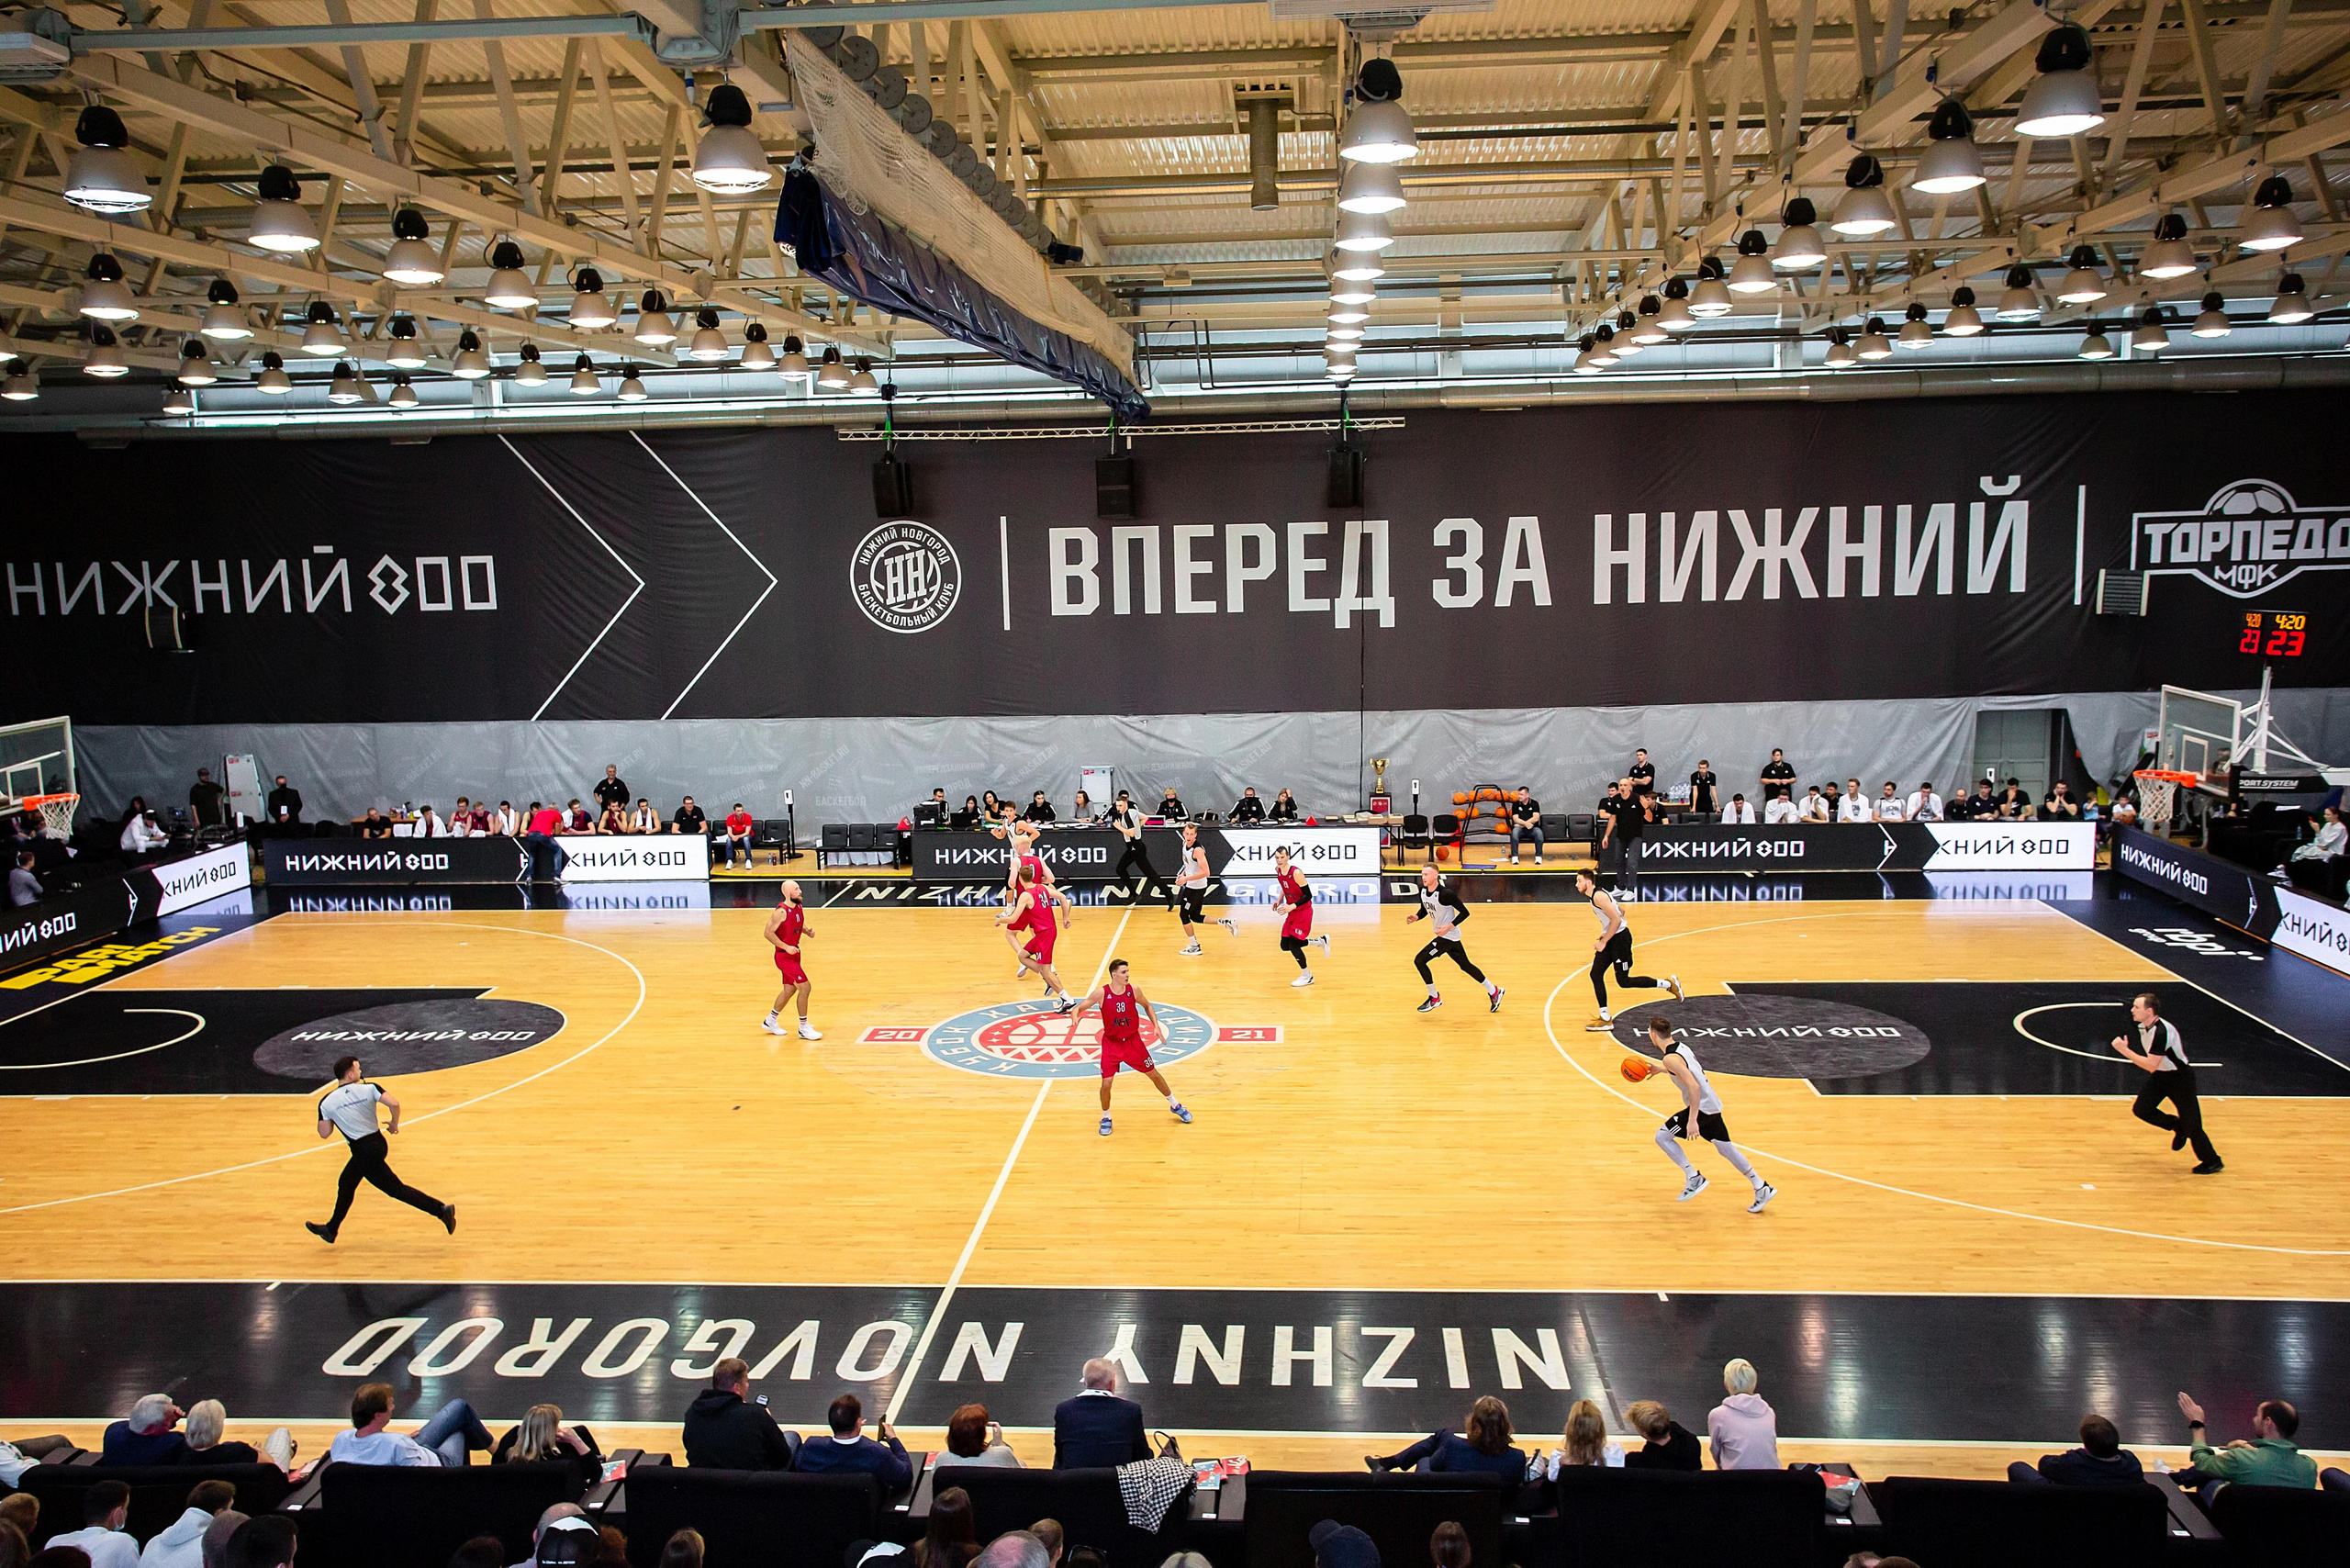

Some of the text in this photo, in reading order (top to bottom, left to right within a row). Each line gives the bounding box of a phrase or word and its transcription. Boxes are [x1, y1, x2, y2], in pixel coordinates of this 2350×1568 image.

[859, 526, 950, 566] НИЖНИЙ НОВГОРОД
[1049, 475, 2030, 629] ВПЕРЕД ЗА НИЖНИЙ
[6, 545, 498, 615] НИЖНИЙ 800
[2214, 564, 2279, 589] МФК
[858, 582, 955, 627] БАСКЕТБОЛЬНЫЙ КЛУБ
[2275, 614, 2306, 630] 4:20
[2240, 630, 2261, 654] 23
[2266, 631, 2306, 656] 23
[799, 744, 850, 789] NN-BASKET.RU
[2239, 779, 2300, 789] PORT SYSTEM
[935, 844, 1107, 865] НИЖНЙ 800
[1311, 845, 1357, 861] 800
[1627, 837, 1805, 858] ИЖНИЙ 800
[2020, 838, 2070, 856] 800
[285, 850, 449, 871] НИЖНИЙ 800
[642, 851, 686, 867] 800
[2121, 843, 2209, 895] НИЖНИЙ 800
[209, 861, 236, 883] 800
[1038, 890, 1050, 909] 34
[40, 913, 76, 938] 800
[51, 926, 223, 984] MATCH
[0, 944, 136, 990] PARI
[1115, 1002, 1125, 1013] 38
[290, 1029, 466, 1041] НИЖНИЙ
[873, 1028, 918, 1041] 20
[1231, 1028, 1267, 1041] 21
[935, 1025, 1020, 1073] КУБОК
[321, 1316, 1572, 1390] NIZHNY NOVGOROD
